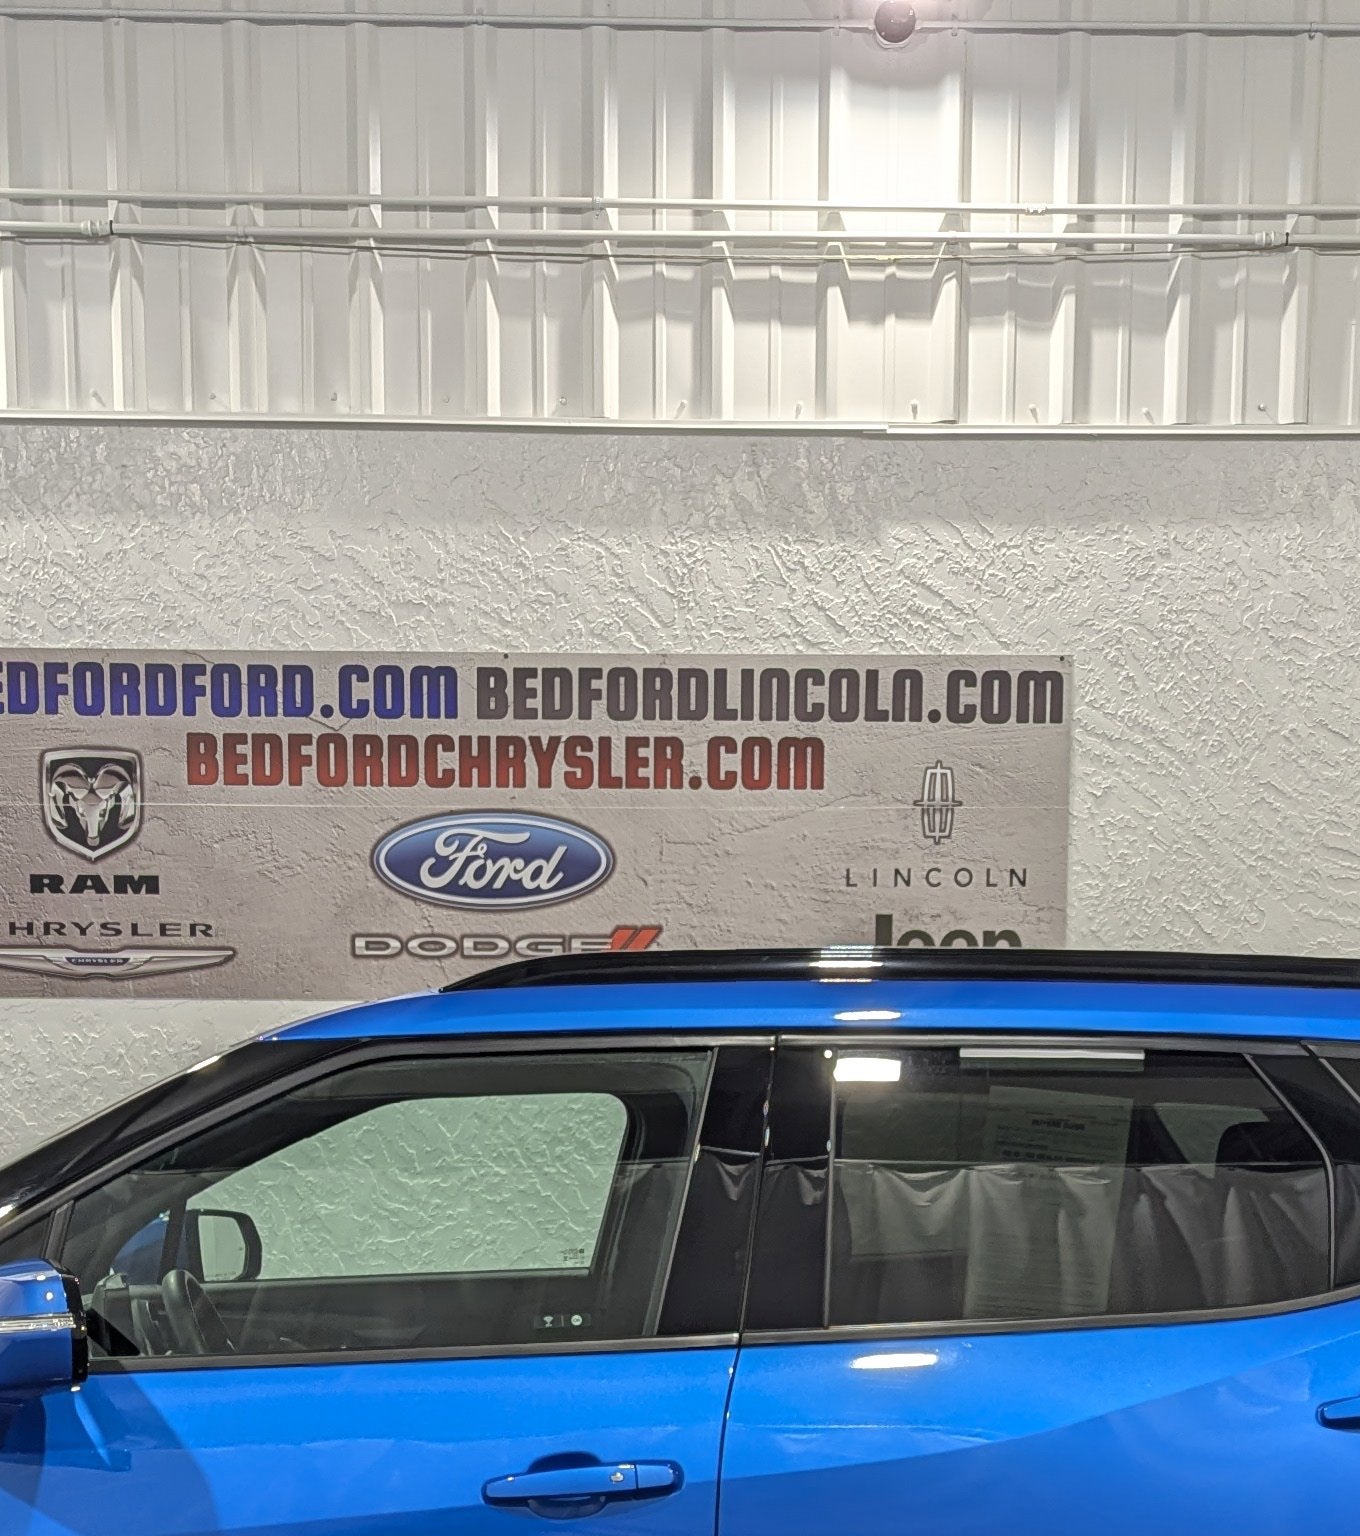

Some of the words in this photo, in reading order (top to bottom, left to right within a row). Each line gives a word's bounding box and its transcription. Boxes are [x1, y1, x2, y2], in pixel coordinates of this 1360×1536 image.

[476, 666, 1064, 725] BEDFORDLINCOLN.COM
[186, 732, 825, 790] BEDFORDCHRYSLER.COM
[419, 827, 569, 890] Ford
[845, 867, 1028, 889] LINCOLN
[29, 873, 160, 895] RAM
[352, 935, 613, 957] DODGE
